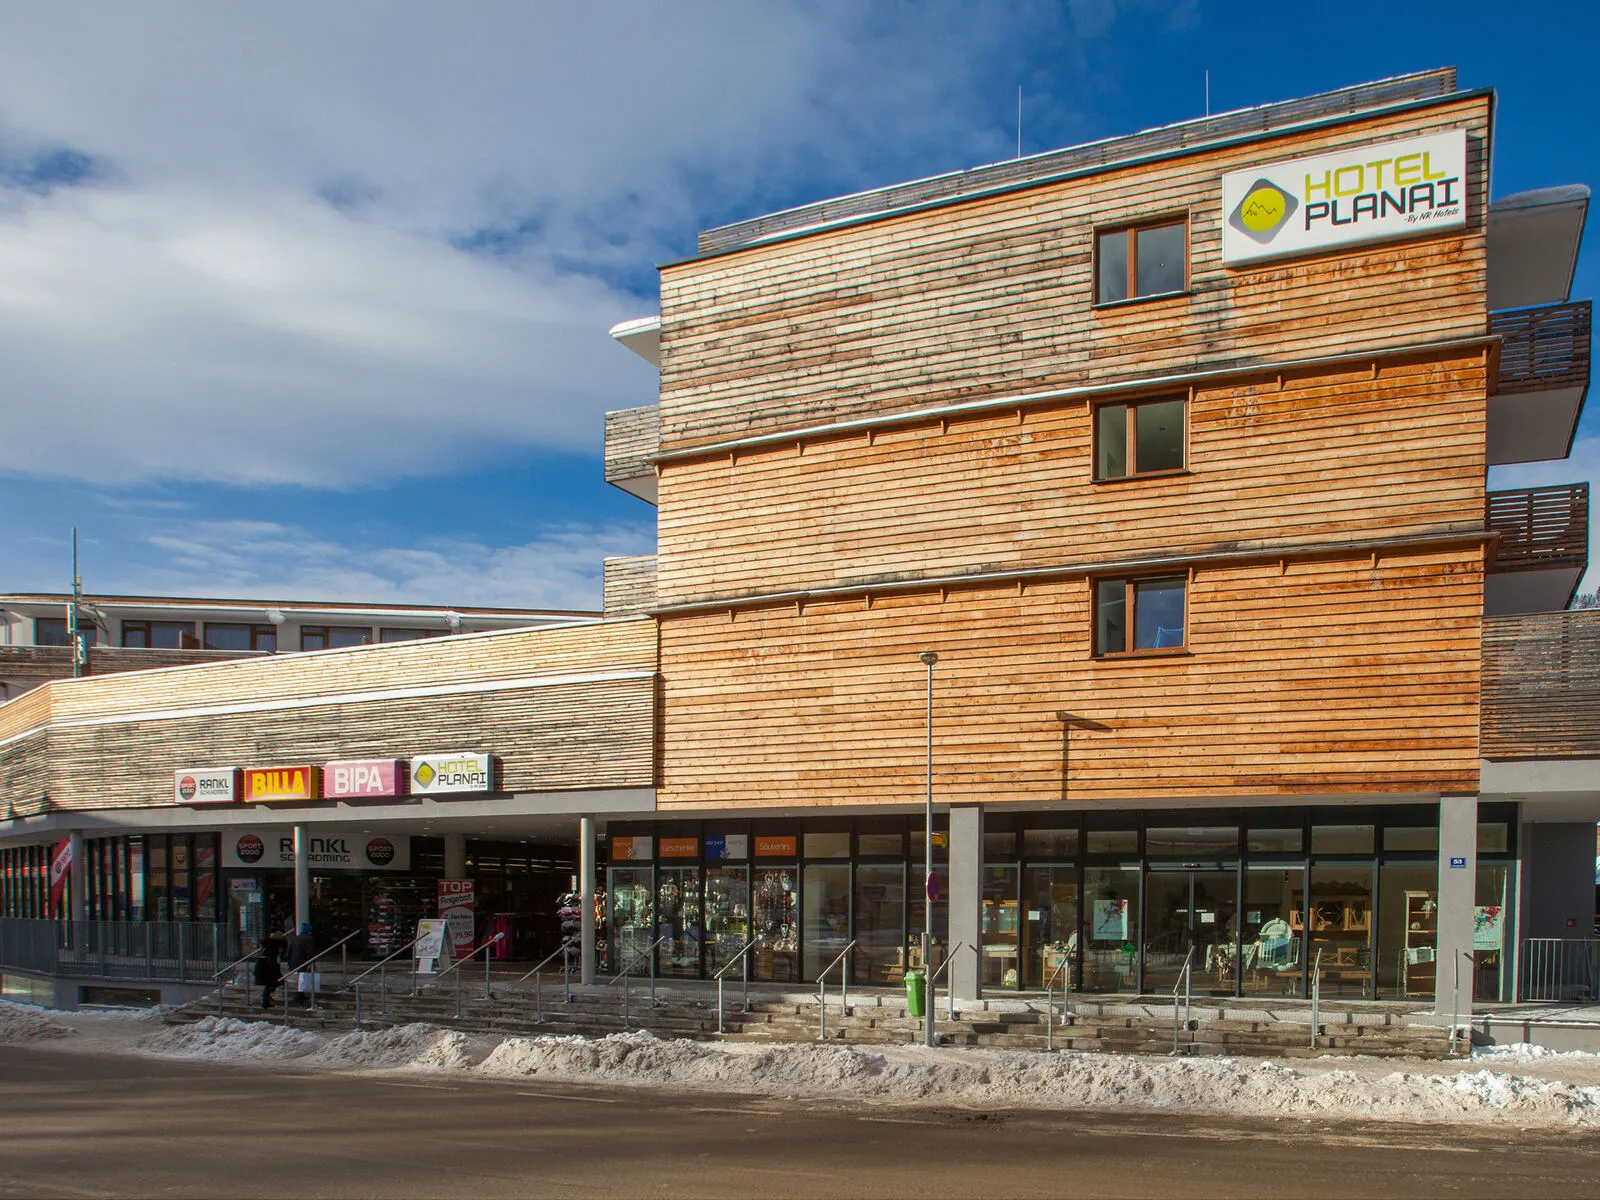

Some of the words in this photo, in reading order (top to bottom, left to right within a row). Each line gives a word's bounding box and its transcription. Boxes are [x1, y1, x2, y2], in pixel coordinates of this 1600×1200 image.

[1304, 151, 1445, 202] HOTEL
[1305, 177, 1459, 231] PLANAI
[1419, 211, 1432, 221] NR
[1433, 207, 1459, 218] Hotels
[437, 759, 482, 774] HOTEL
[199, 779, 229, 789] RANKL
[252, 770, 305, 796] BILLA
[333, 766, 384, 794] BIPA
[438, 772, 487, 786] PLANAI
[279, 838, 350, 853] RNKL
[279, 853, 351, 862] SCADMING
[439, 881, 473, 892] TOP
[440, 893, 473, 905] Angebot
